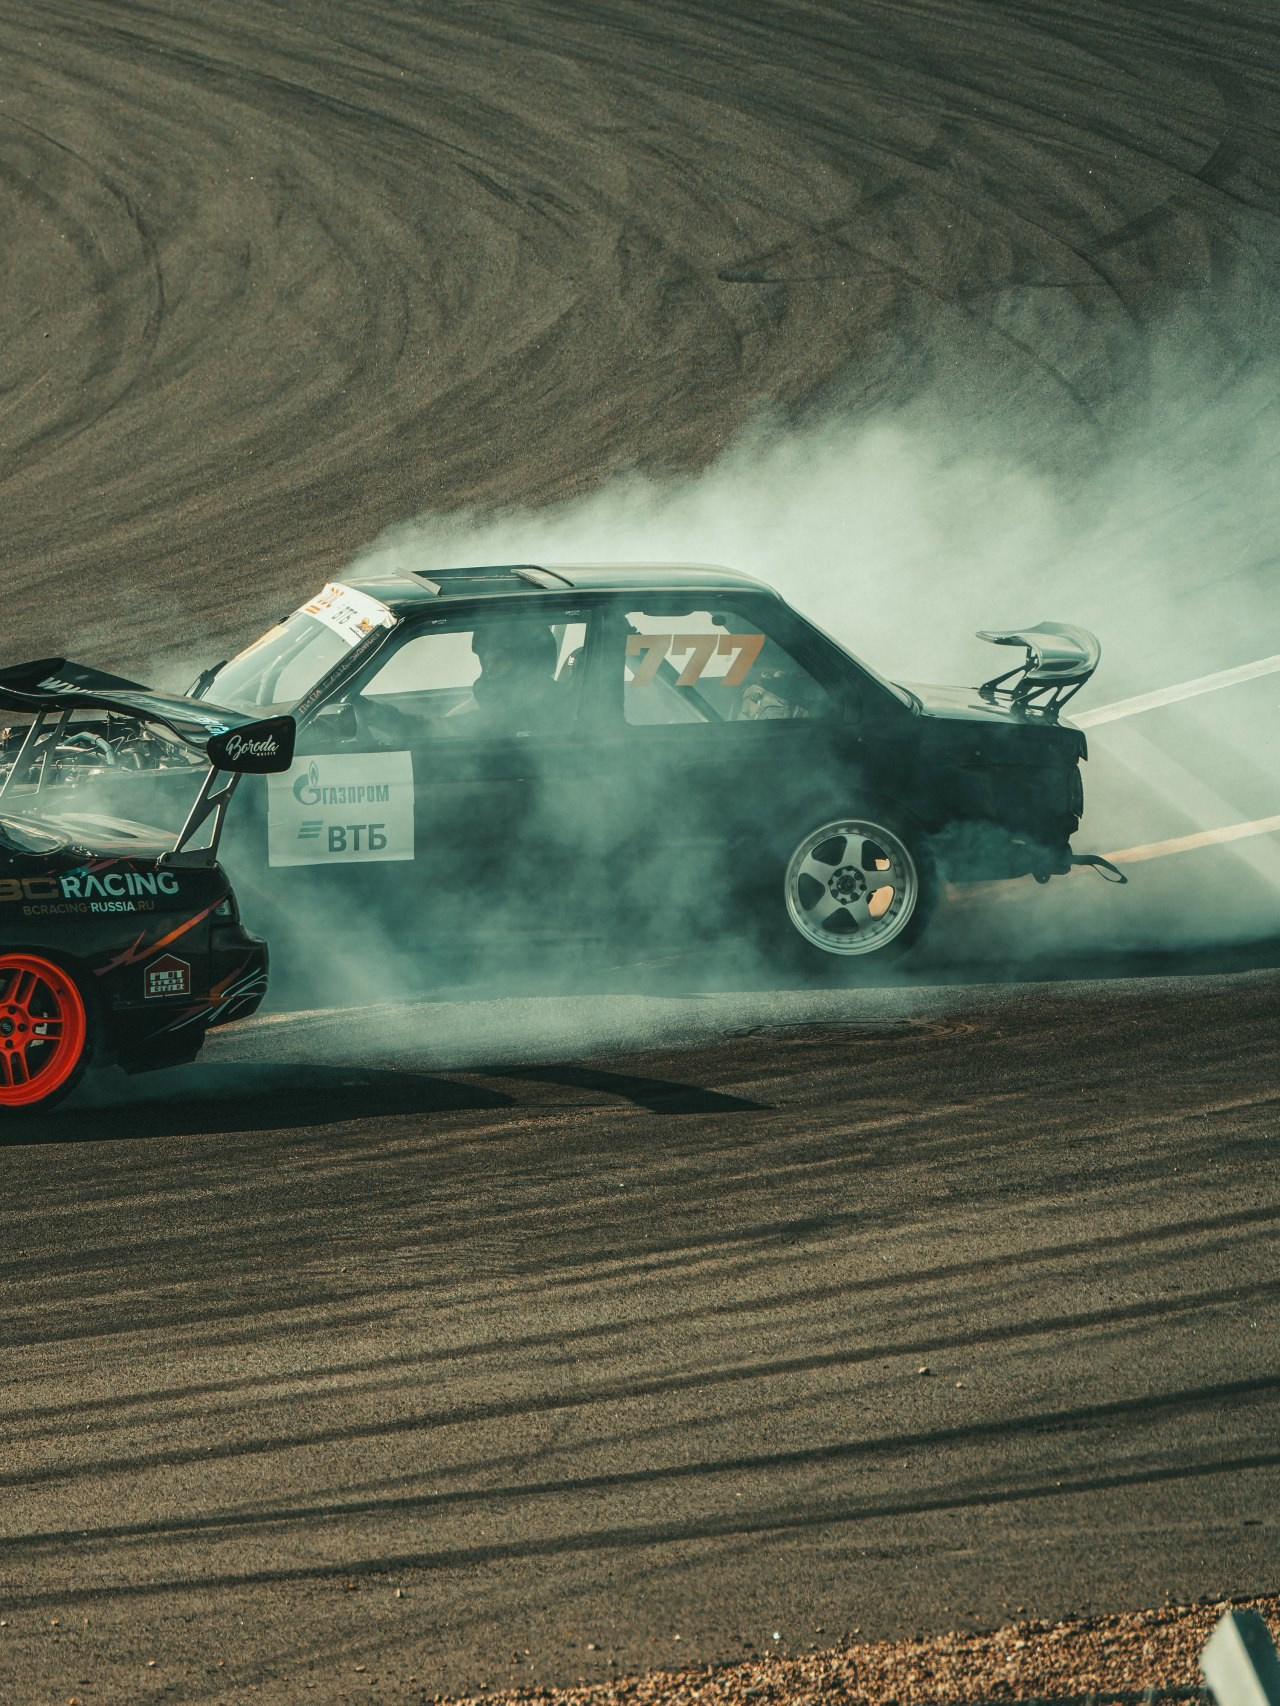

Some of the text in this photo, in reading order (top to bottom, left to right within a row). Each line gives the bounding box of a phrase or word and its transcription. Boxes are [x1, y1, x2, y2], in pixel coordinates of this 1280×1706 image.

[625, 634, 766, 687] 777
[225, 734, 280, 761] Boroda
[322, 785, 390, 805] ГАЗПРОМ
[328, 823, 388, 853] ВТБ
